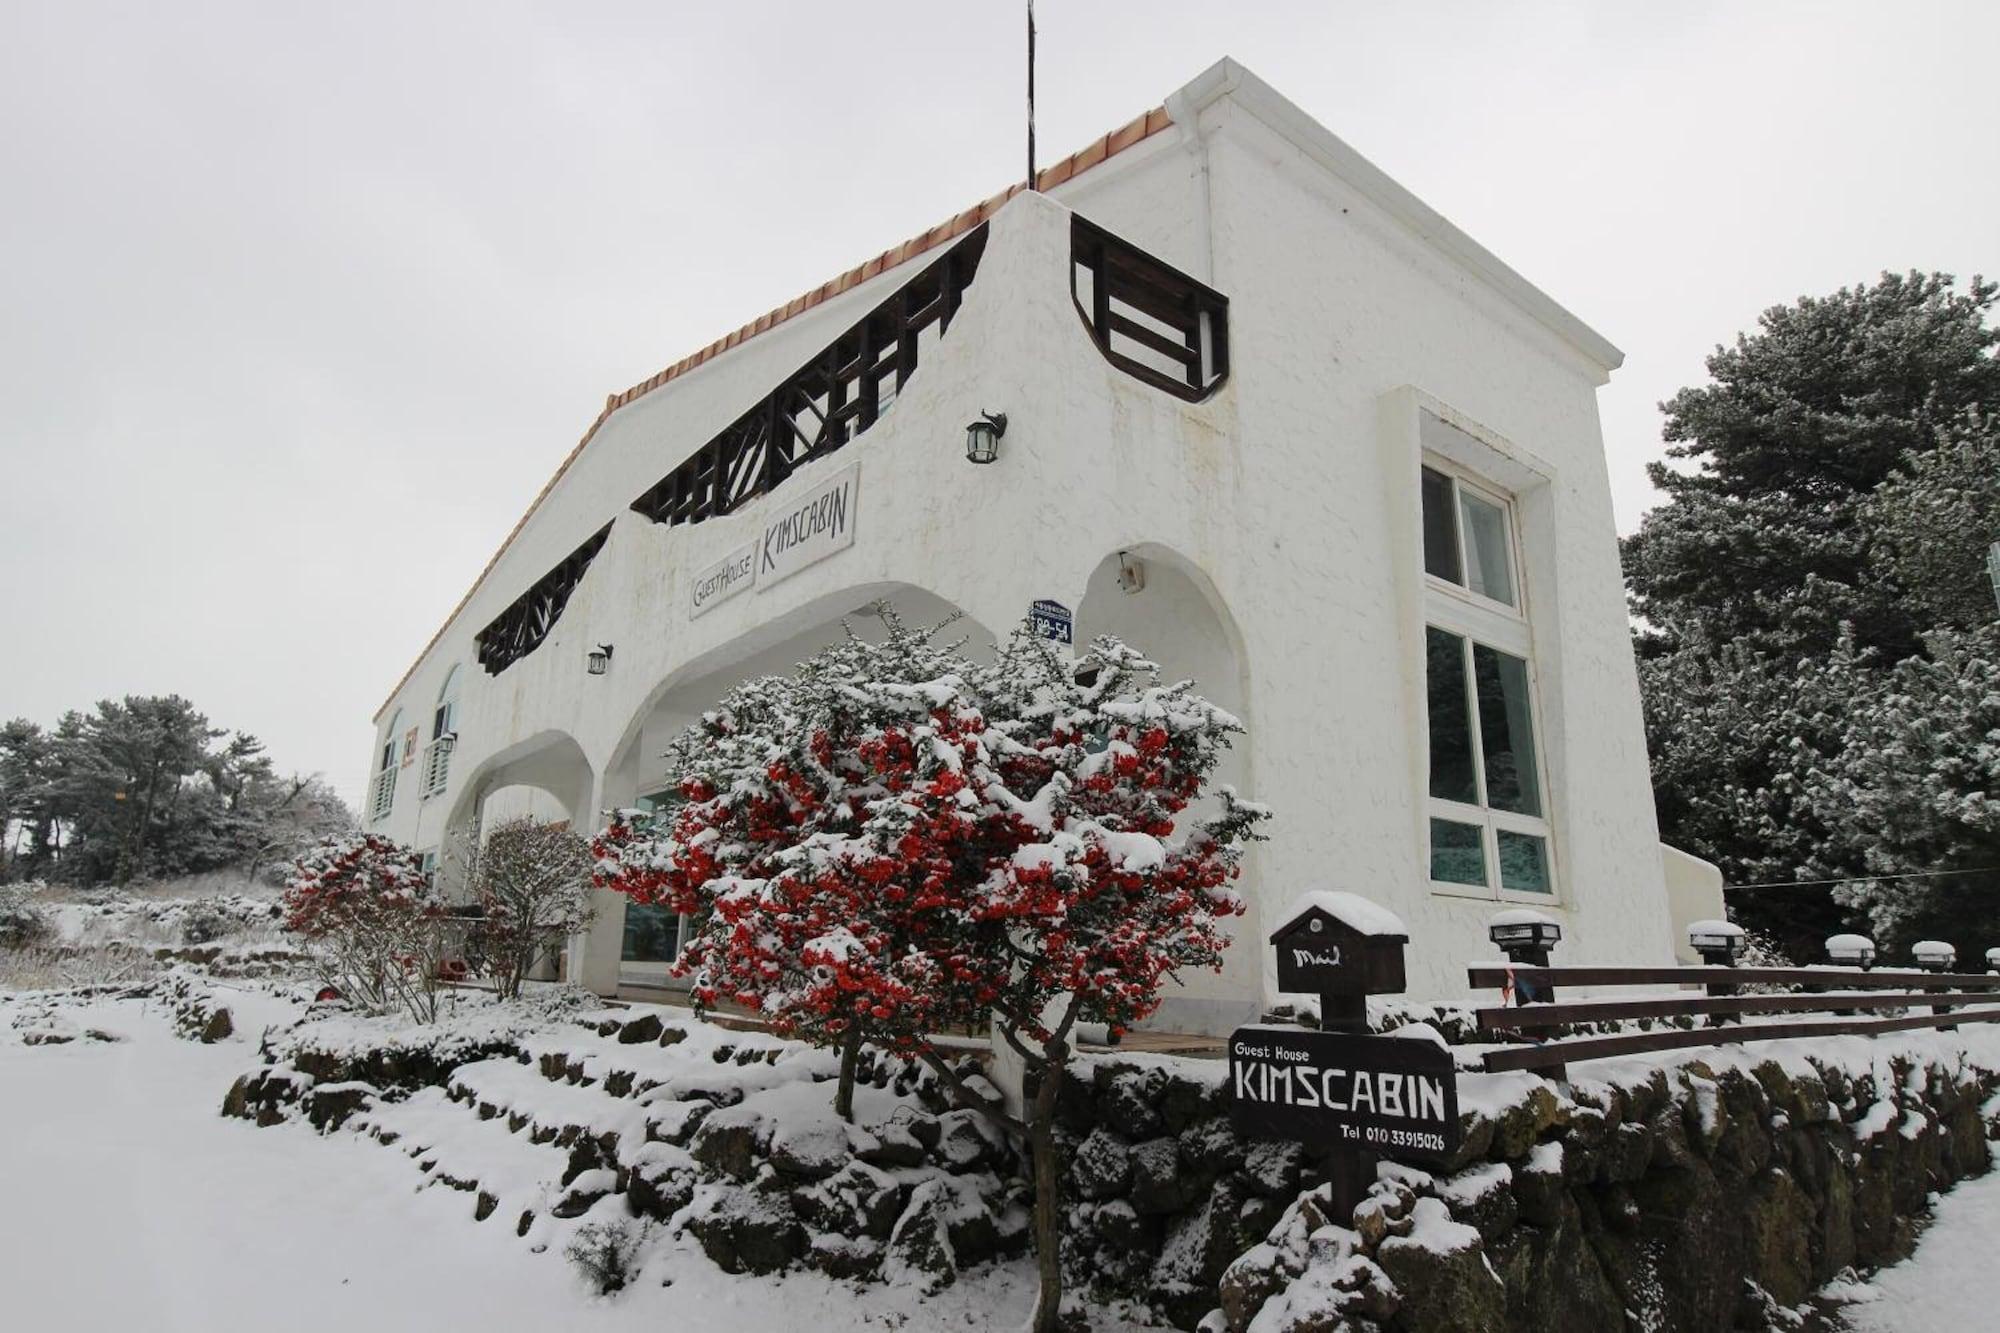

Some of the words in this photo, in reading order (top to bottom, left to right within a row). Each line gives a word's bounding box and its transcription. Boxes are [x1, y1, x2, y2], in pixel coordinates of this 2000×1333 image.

[762, 481, 849, 574] KIMSCABIN
[1292, 945, 1342, 968] Mail
[1234, 1041, 1271, 1059] Guest
[1275, 1045, 1310, 1062] House
[1234, 1060, 1446, 1122] KIMSCABIN
[1340, 1123, 1361, 1140] Tel
[1365, 1126, 1389, 1144] 010
[1390, 1129, 1446, 1152] 33915026
